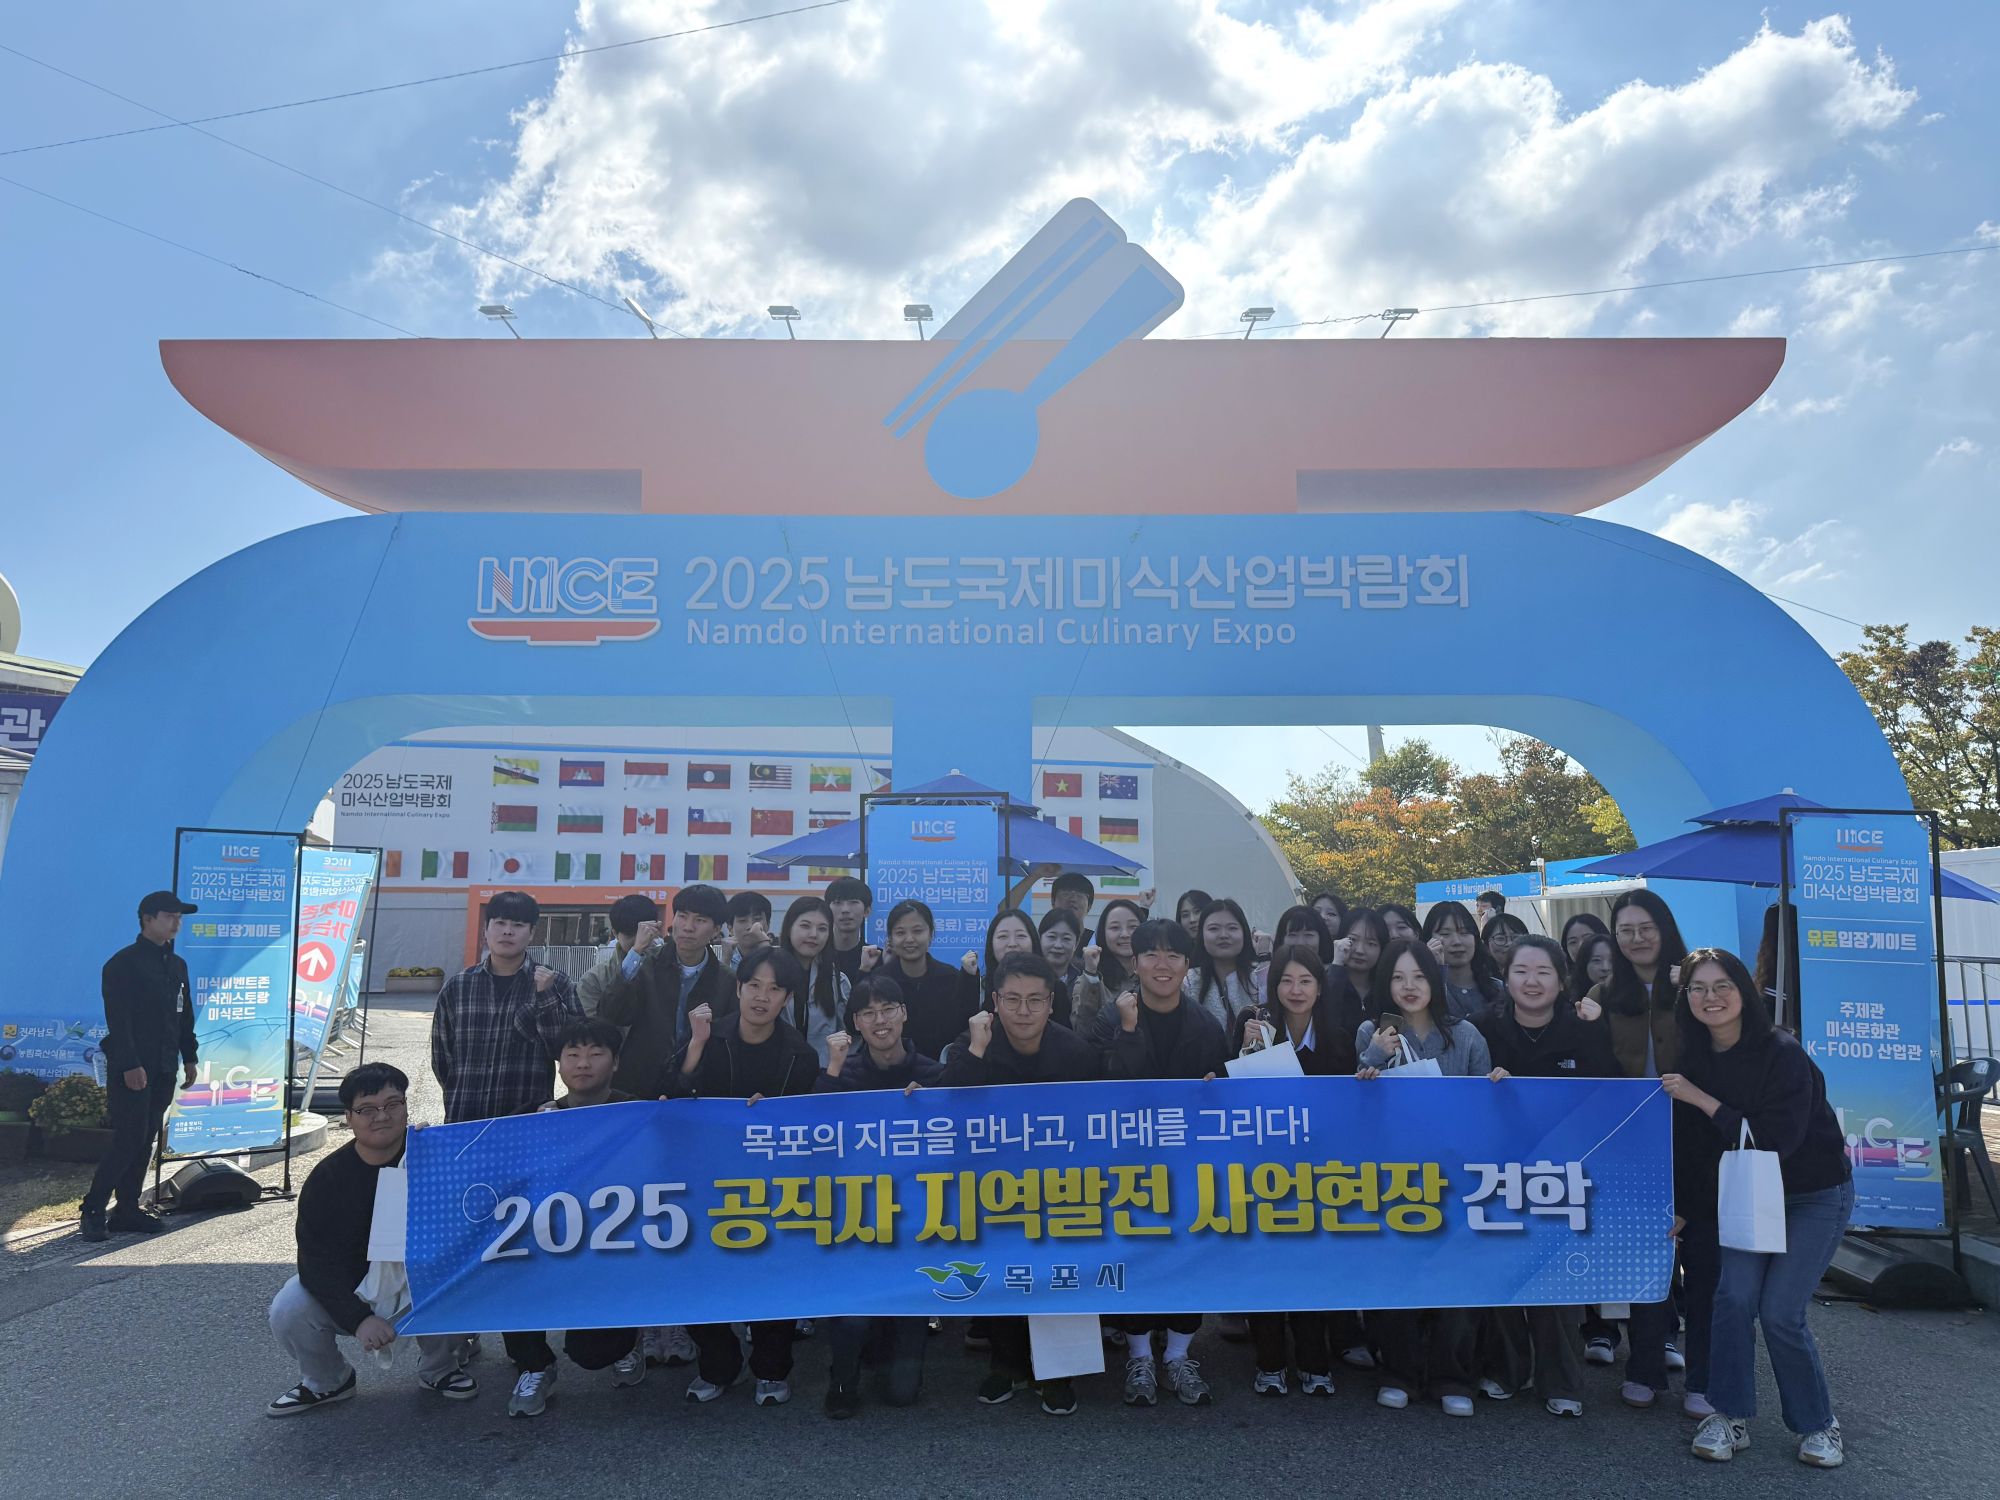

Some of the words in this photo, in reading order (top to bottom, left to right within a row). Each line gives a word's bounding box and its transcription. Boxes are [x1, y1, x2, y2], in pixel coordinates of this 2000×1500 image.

[477, 556, 659, 615] NICE
[684, 556, 830, 611] 2025
[844, 553, 1471, 611] 남도국제미식산업박람회
[687, 618, 807, 646] Namdo
[820, 617, 1044, 646] International
[1056, 617, 1200, 651] Culinary
[1212, 618, 1297, 652] Expo
[343, 773, 383, 789] 2025
[386, 773, 453, 791] 남도국제
[341, 792, 451, 808] 미식산업박람회
[406, 811, 432, 819] Culinary
[911, 820, 956, 834] NICE
[1836, 829, 1884, 845] NICE
[222, 845, 260, 857] NICE
[192, 872, 226, 885] 2025
[230, 873, 286, 888] 남도국제
[878, 868, 918, 884] 2025
[923, 867, 988, 885] 남도국제
[1803, 864, 1845, 881] 2025
[1849, 865, 1919, 884] 남도국제
[190, 887, 286, 902] 미식산업박람회
[878, 887, 988, 904] 미식산업박람회
[1803, 883, 1919, 904] 미식산업박람회
[192, 923, 281, 938] 무료입장게이트
[965, 918, 990, 931] 금지
[1807, 929, 1917, 951] 유료입장게이트
[197, 976, 270, 990] 미식이벤트존
[197, 991, 270, 1006] 미식레스토랑
[208, 1007, 256, 1021] 미식로드
[1840, 1002, 1885, 1019] 주제관
[20, 1027, 54, 1038] 전라남도
[1826, 1020, 1901, 1040] 미식문화관
[1807, 1040, 1874, 1058] K-FOOD
[1877, 1043, 1923, 1061] 산업관
[742, 1120, 845, 1160] 목포의
[854, 1116, 958, 1157] 지금을
[966, 1113, 1075, 1153] 만나고,
[1087, 1108, 1189, 1148] 미래를
[1196, 1105, 1311, 1145] 그리다!
[481, 1182, 689, 1262] 2025
[707, 1174, 901, 1249] 공직자
[915, 1163, 1172, 1243] 지역발전
[1189, 1160, 1448, 1234] 사업현장
[1462, 1160, 1592, 1232] 견학
